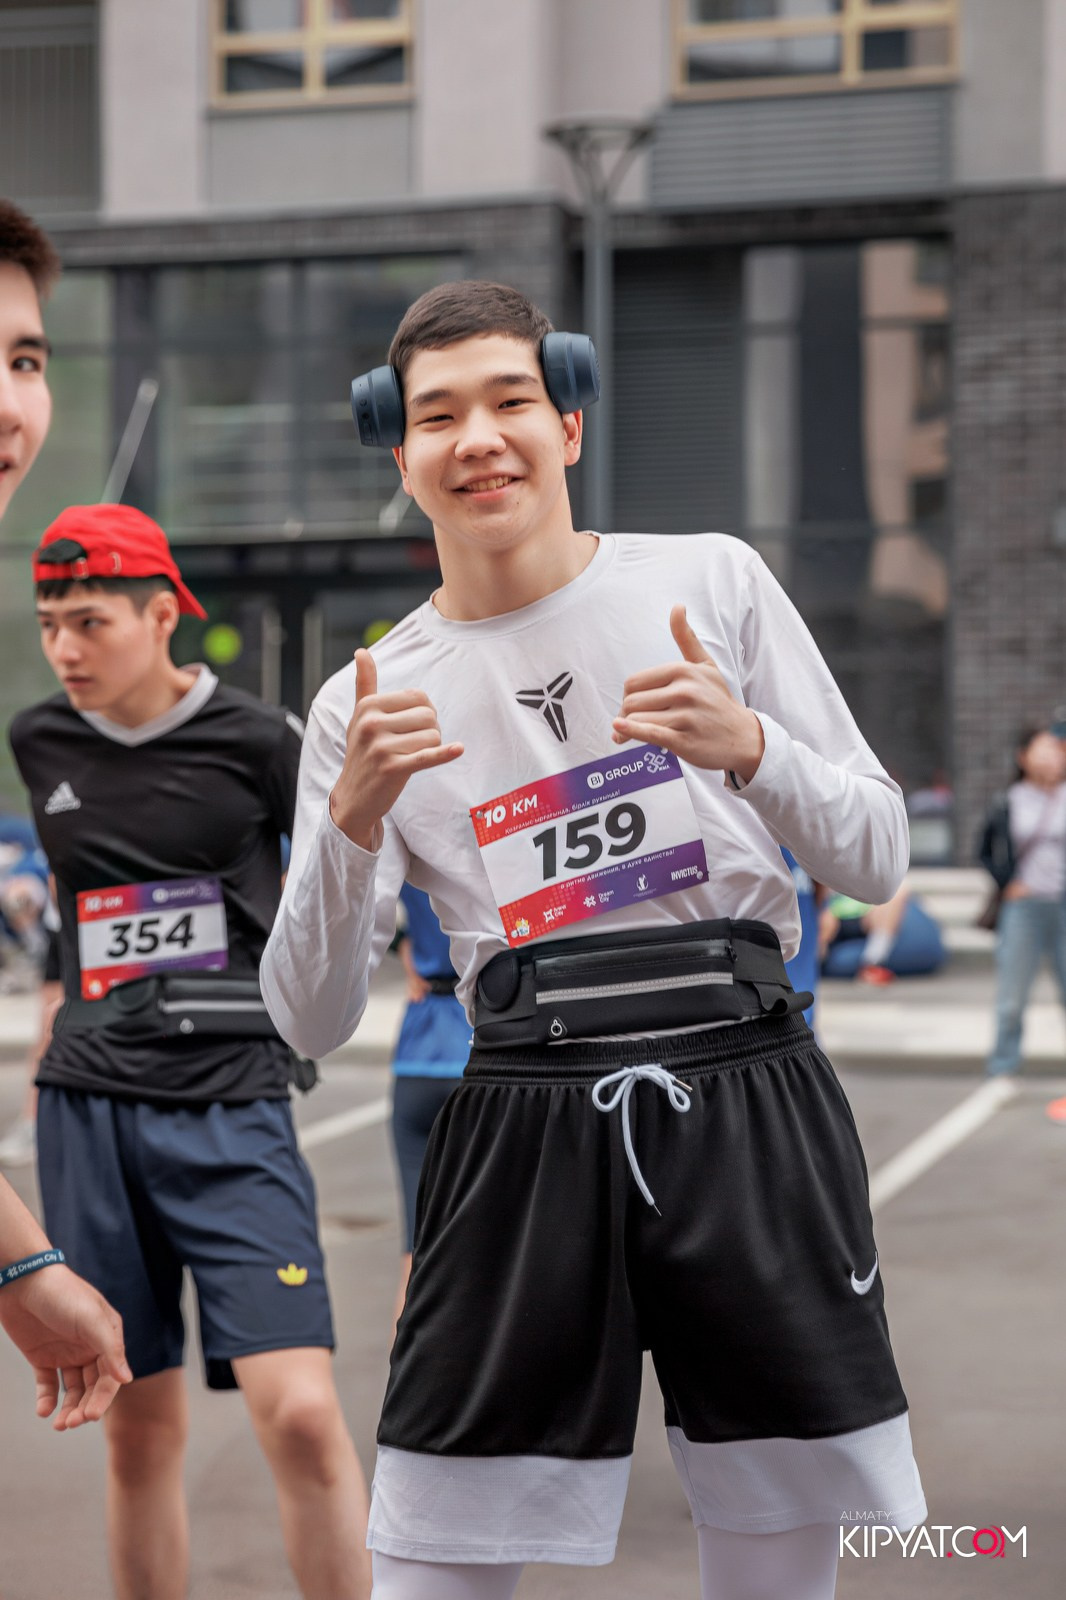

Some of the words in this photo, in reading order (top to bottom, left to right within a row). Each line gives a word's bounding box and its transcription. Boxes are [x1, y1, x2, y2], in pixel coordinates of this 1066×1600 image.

[605, 761, 644, 780] GROUP
[484, 805, 506, 828] 10
[533, 802, 646, 881] 159
[671, 865, 698, 881] INVICTUS
[107, 912, 195, 959] 354
[18, 1257, 44, 1273] Dream
